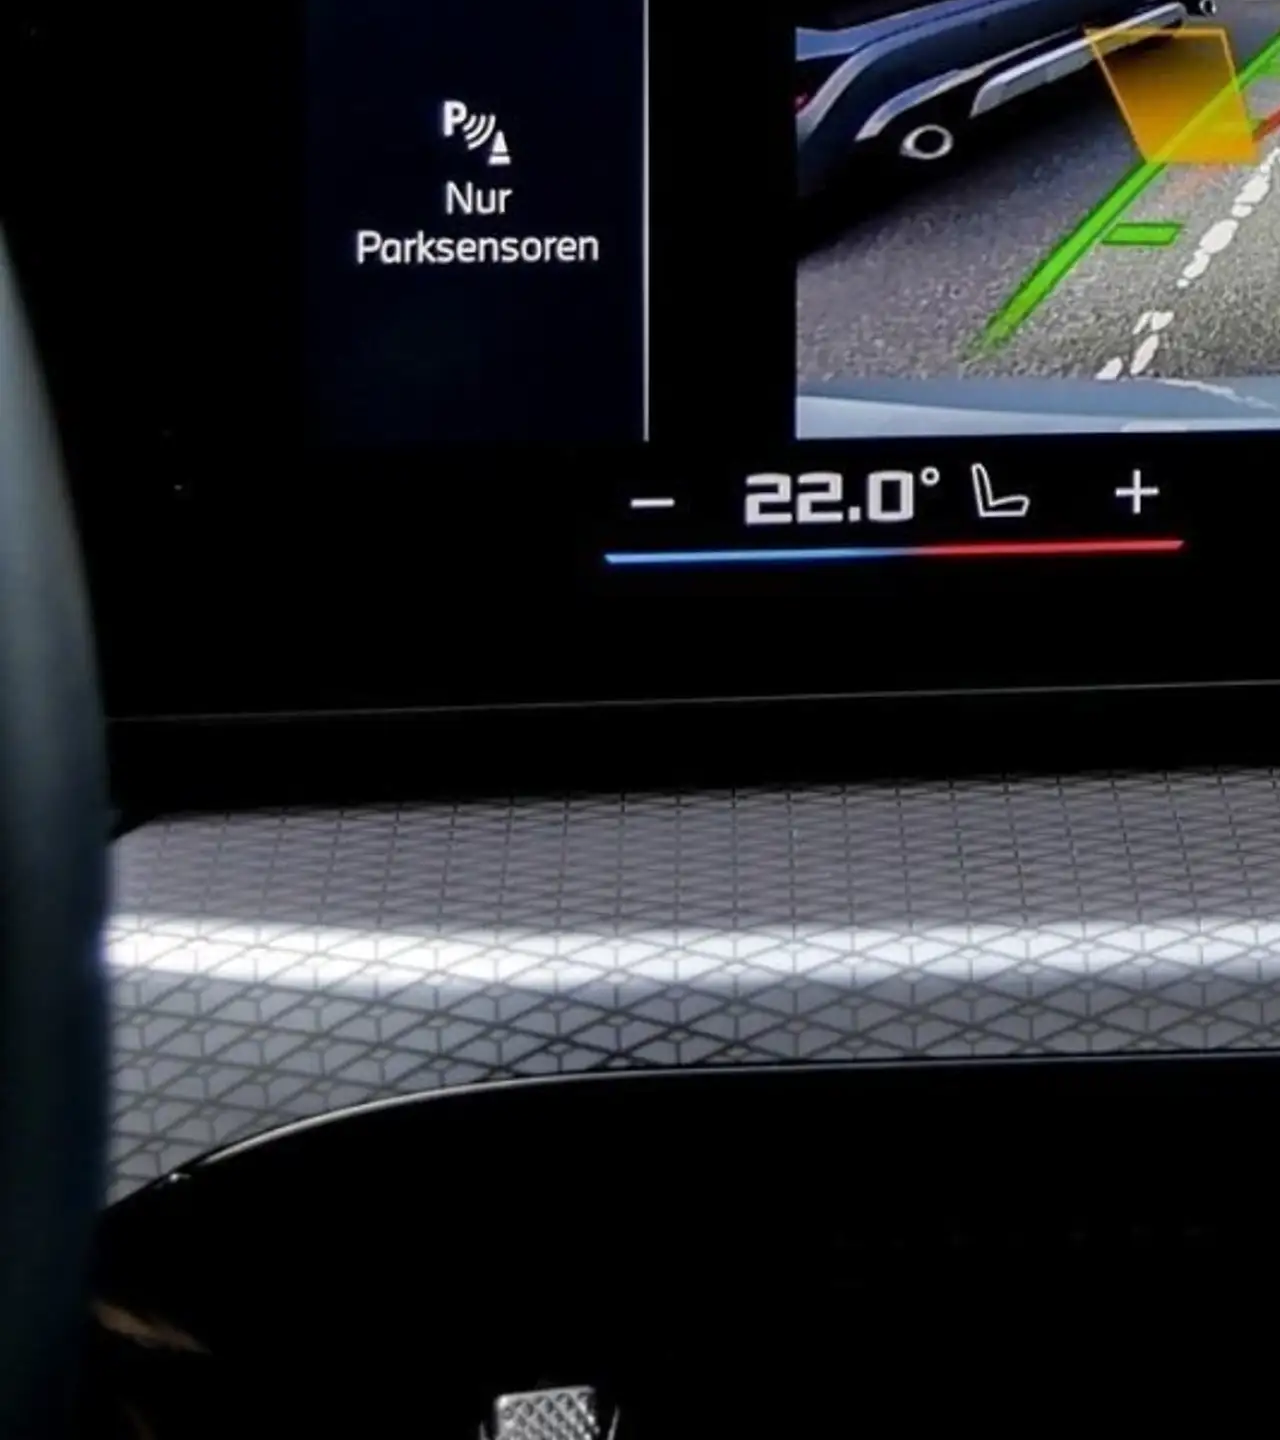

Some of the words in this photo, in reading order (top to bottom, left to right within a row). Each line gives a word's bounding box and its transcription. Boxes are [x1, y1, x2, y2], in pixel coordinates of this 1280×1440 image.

[445, 180, 513, 215] Nur
[356, 229, 599, 264] Parksensoren
[744, 466, 940, 524] 22.0°
